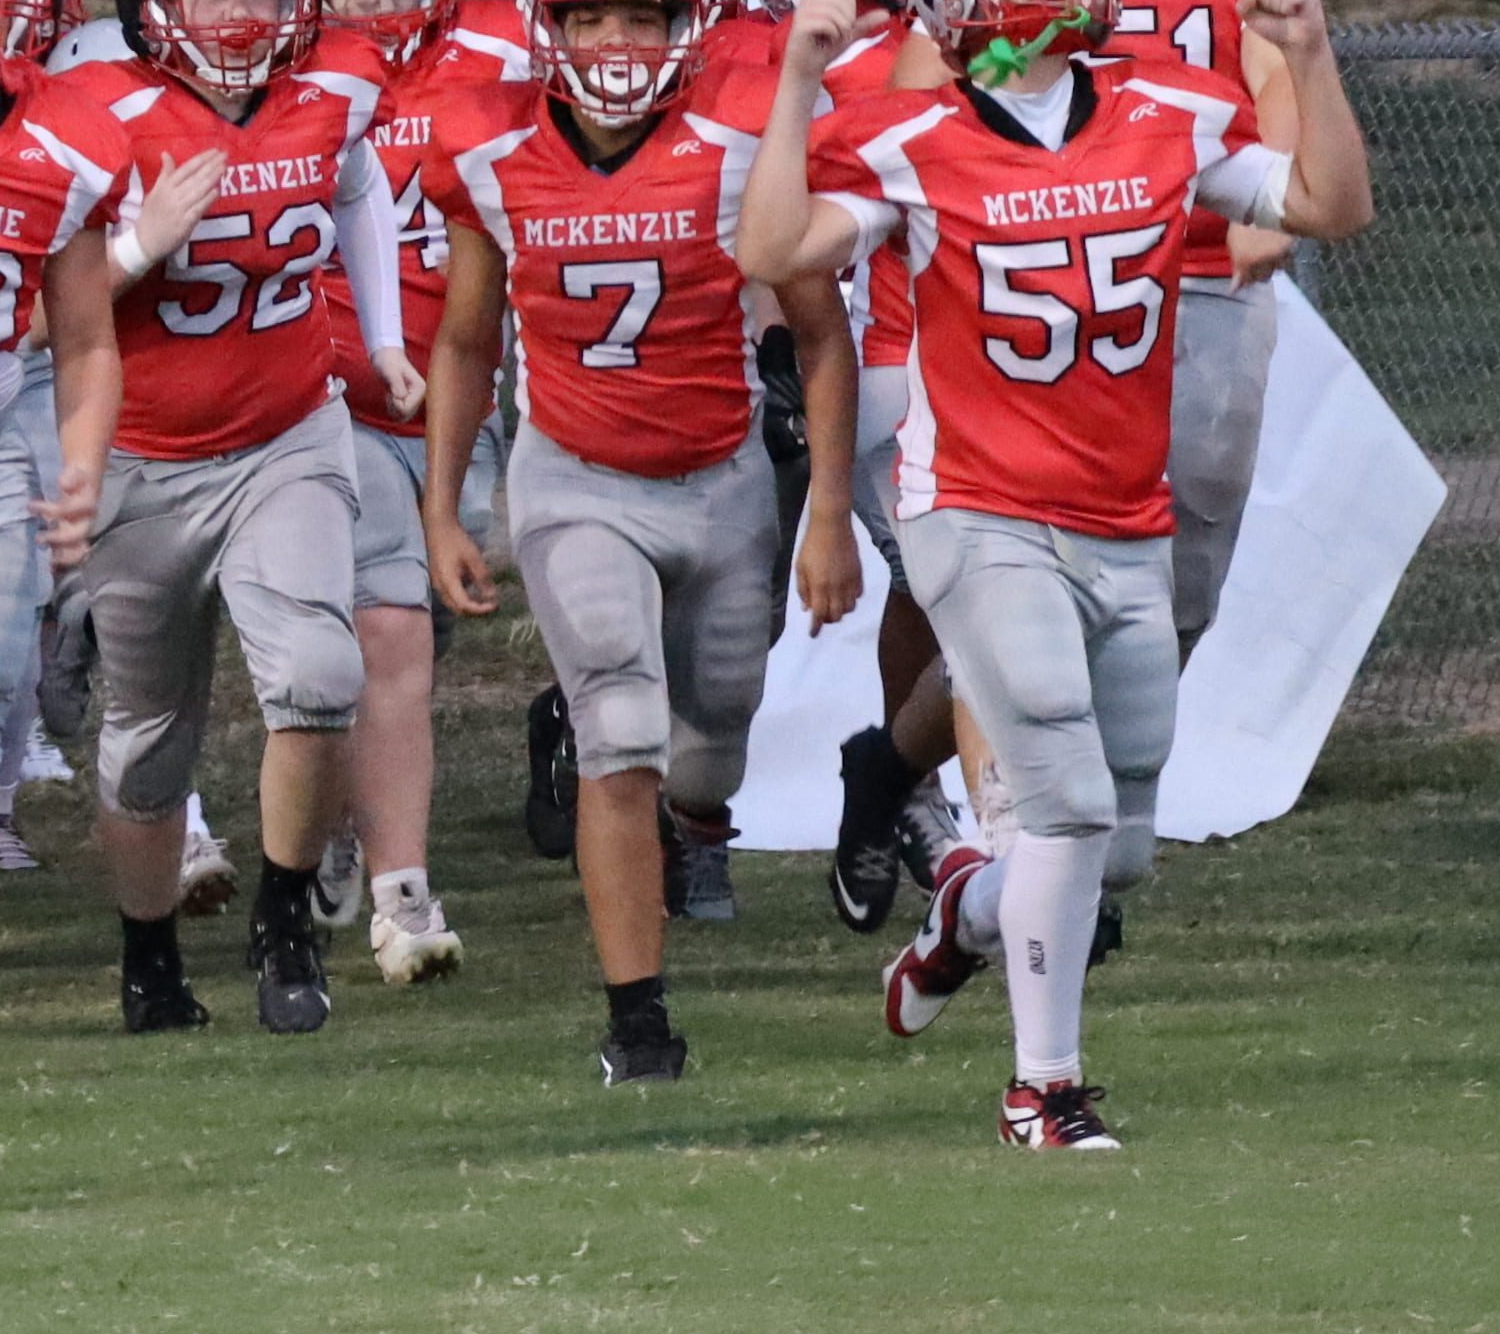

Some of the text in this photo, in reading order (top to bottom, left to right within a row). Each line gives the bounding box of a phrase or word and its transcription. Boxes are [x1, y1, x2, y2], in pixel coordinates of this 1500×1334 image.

[212, 153, 325, 197] KENZIE
[981, 176, 1154, 227] MCKENZIE
[156, 200, 338, 336] 52
[523, 208, 698, 248] MCKENZIE
[560, 257, 664, 368] 7
[973, 220, 1169, 386] 55
